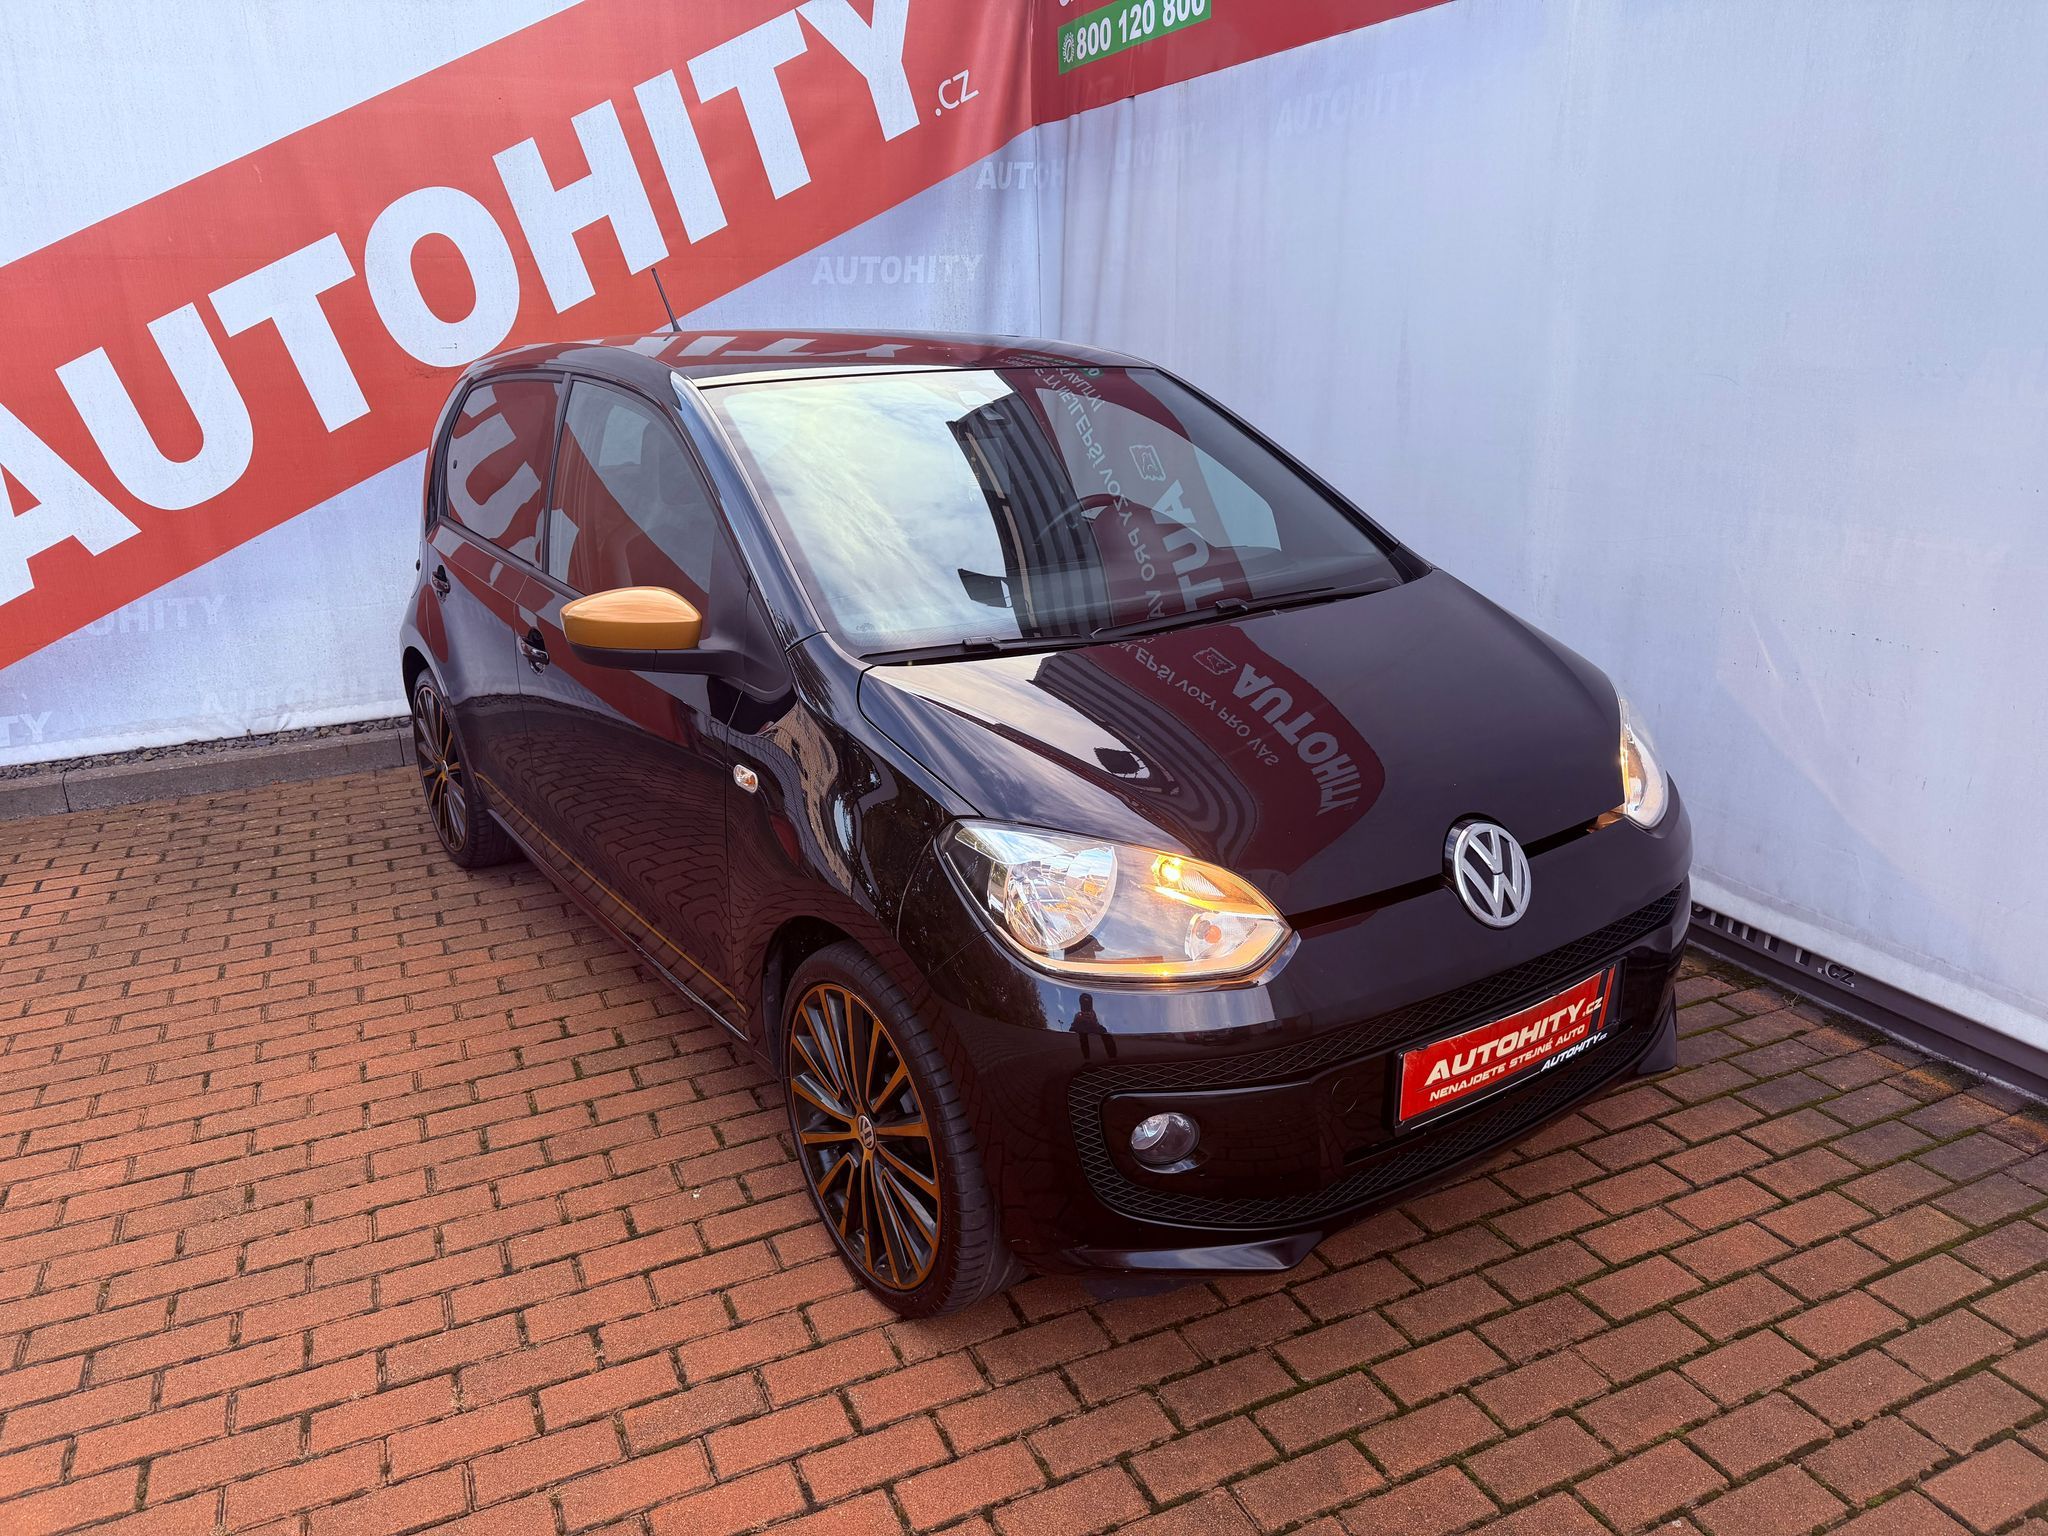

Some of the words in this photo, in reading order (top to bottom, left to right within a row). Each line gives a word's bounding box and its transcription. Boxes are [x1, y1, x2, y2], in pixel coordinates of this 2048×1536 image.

[1076, 17, 1112, 60] 800
[1118, 1, 1155, 43] 120
[811, 254, 984, 285] AUTOHITY
[1453, 823, 1531, 928] VW
[1429, 1064, 1506, 1101] NENAJDETE
[1509, 1038, 1553, 1069] STEJNÉ
[1555, 1024, 1586, 1047] AUTO
